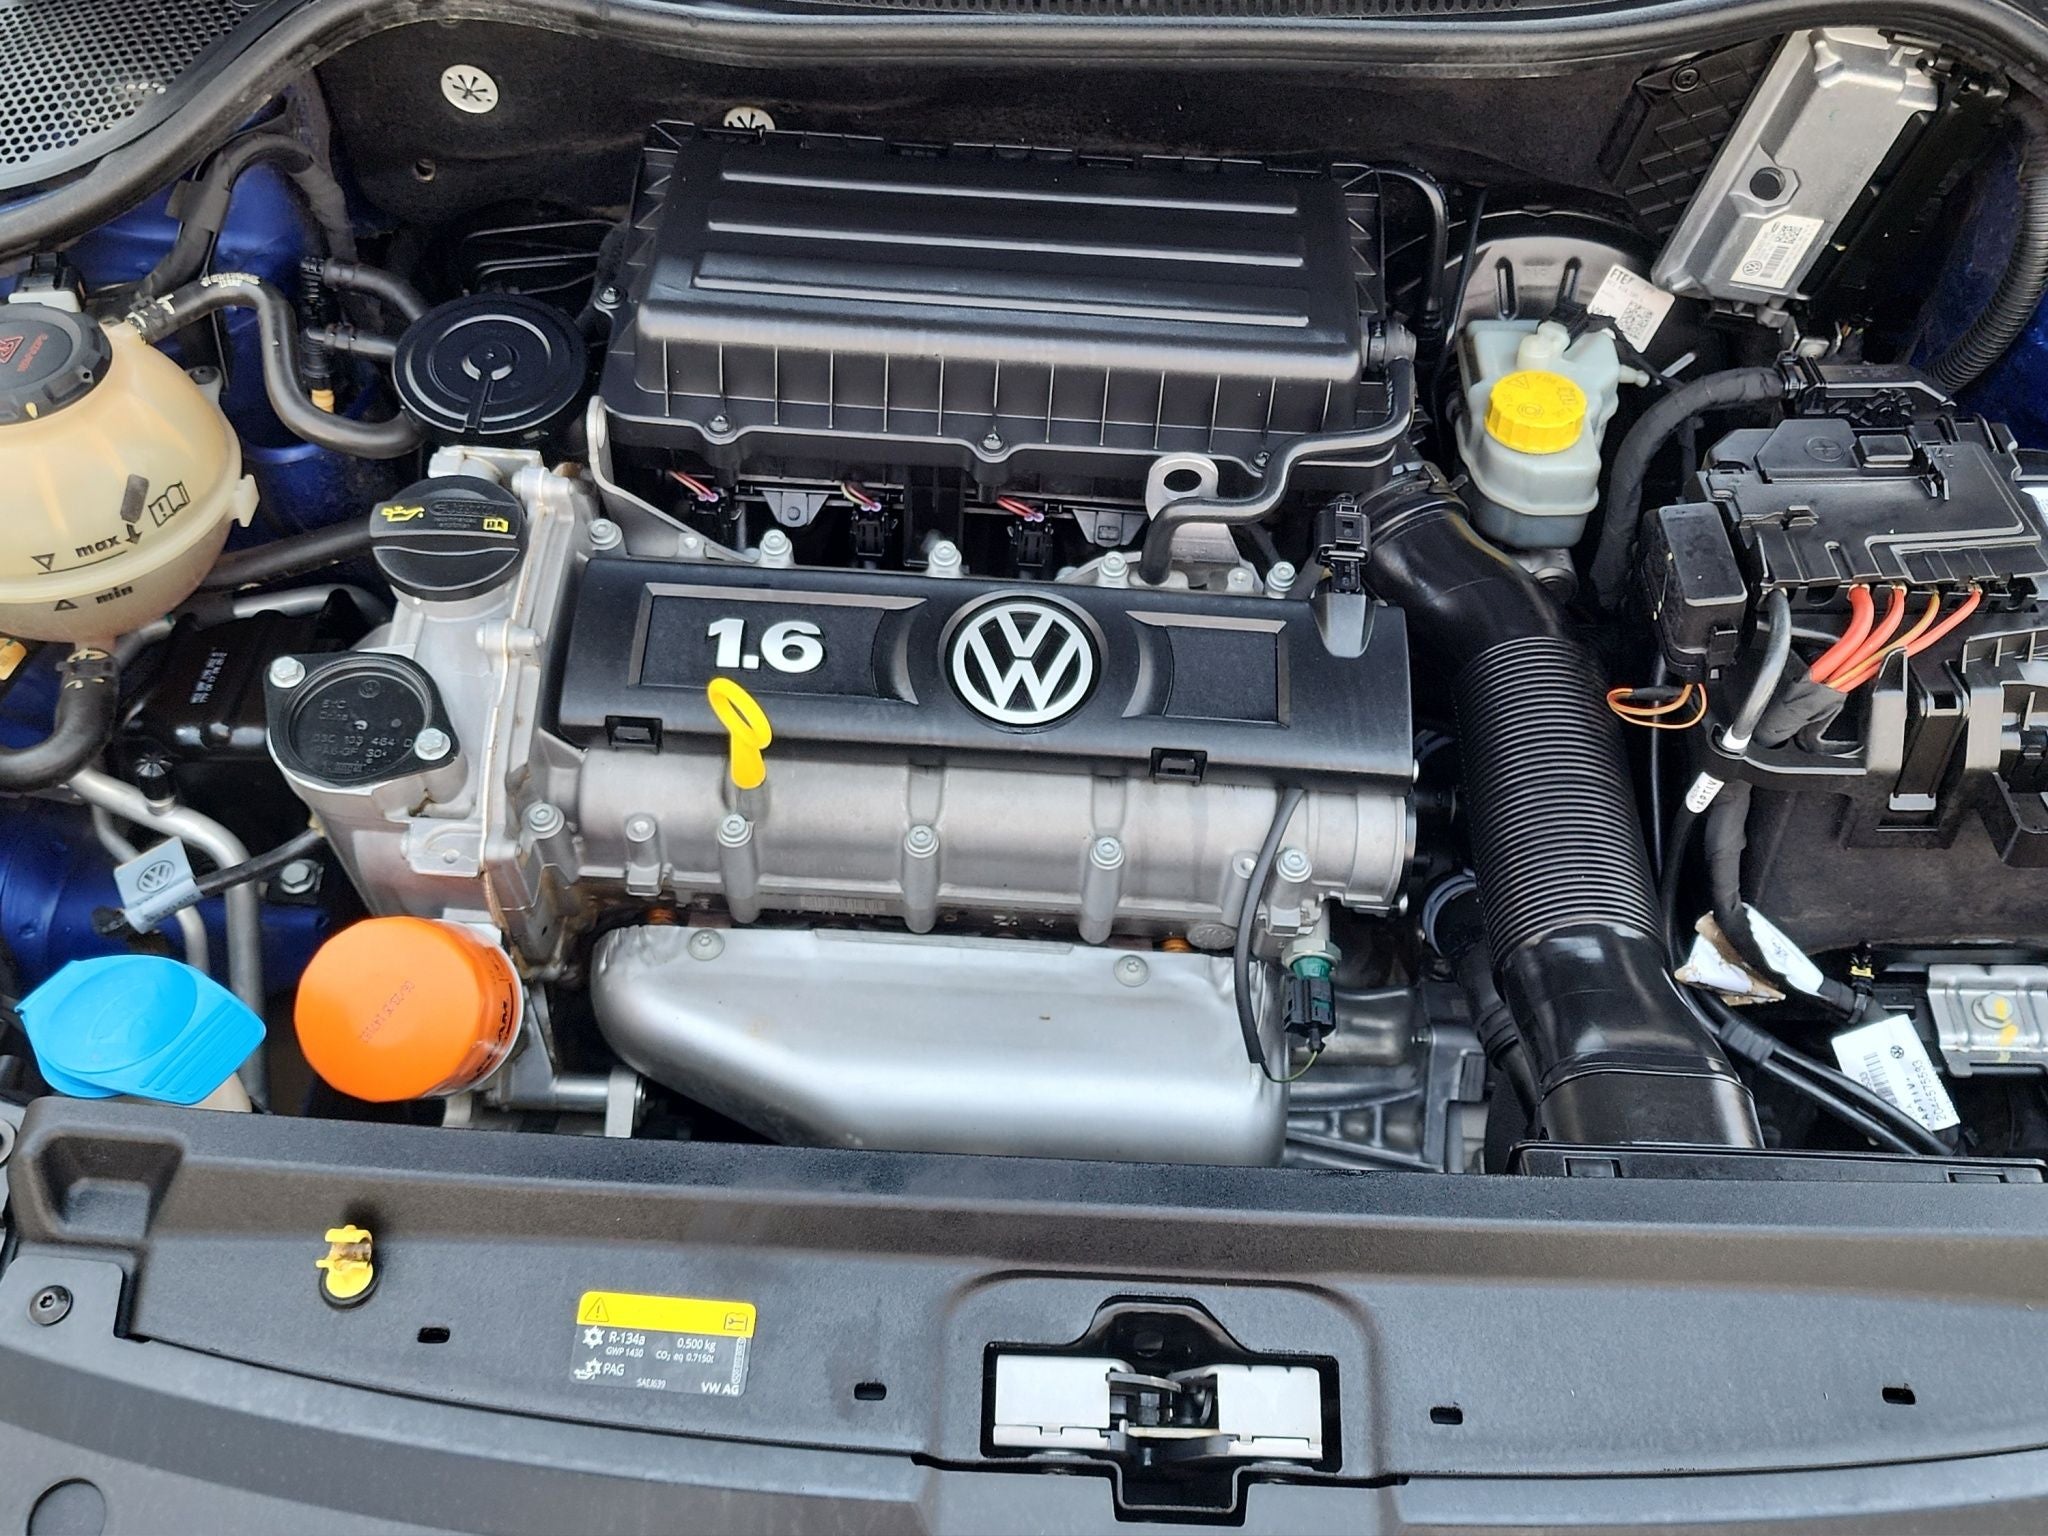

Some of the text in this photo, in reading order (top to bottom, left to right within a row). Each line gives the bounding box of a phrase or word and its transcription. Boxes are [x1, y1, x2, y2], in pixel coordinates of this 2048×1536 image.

[75, 536, 121, 558] max
[96, 585, 133, 604] min
[706, 617, 824, 674] 1.6
[609, 1331, 716, 1353] R-134a 0.500 kg
[605, 1346, 624, 1356] GWP
[625, 1347, 644, 1358] 1430
[673, 1353, 683, 1363] eq
[602, 1361, 625, 1376] PAG
[701, 1382, 739, 1395] VW AG
